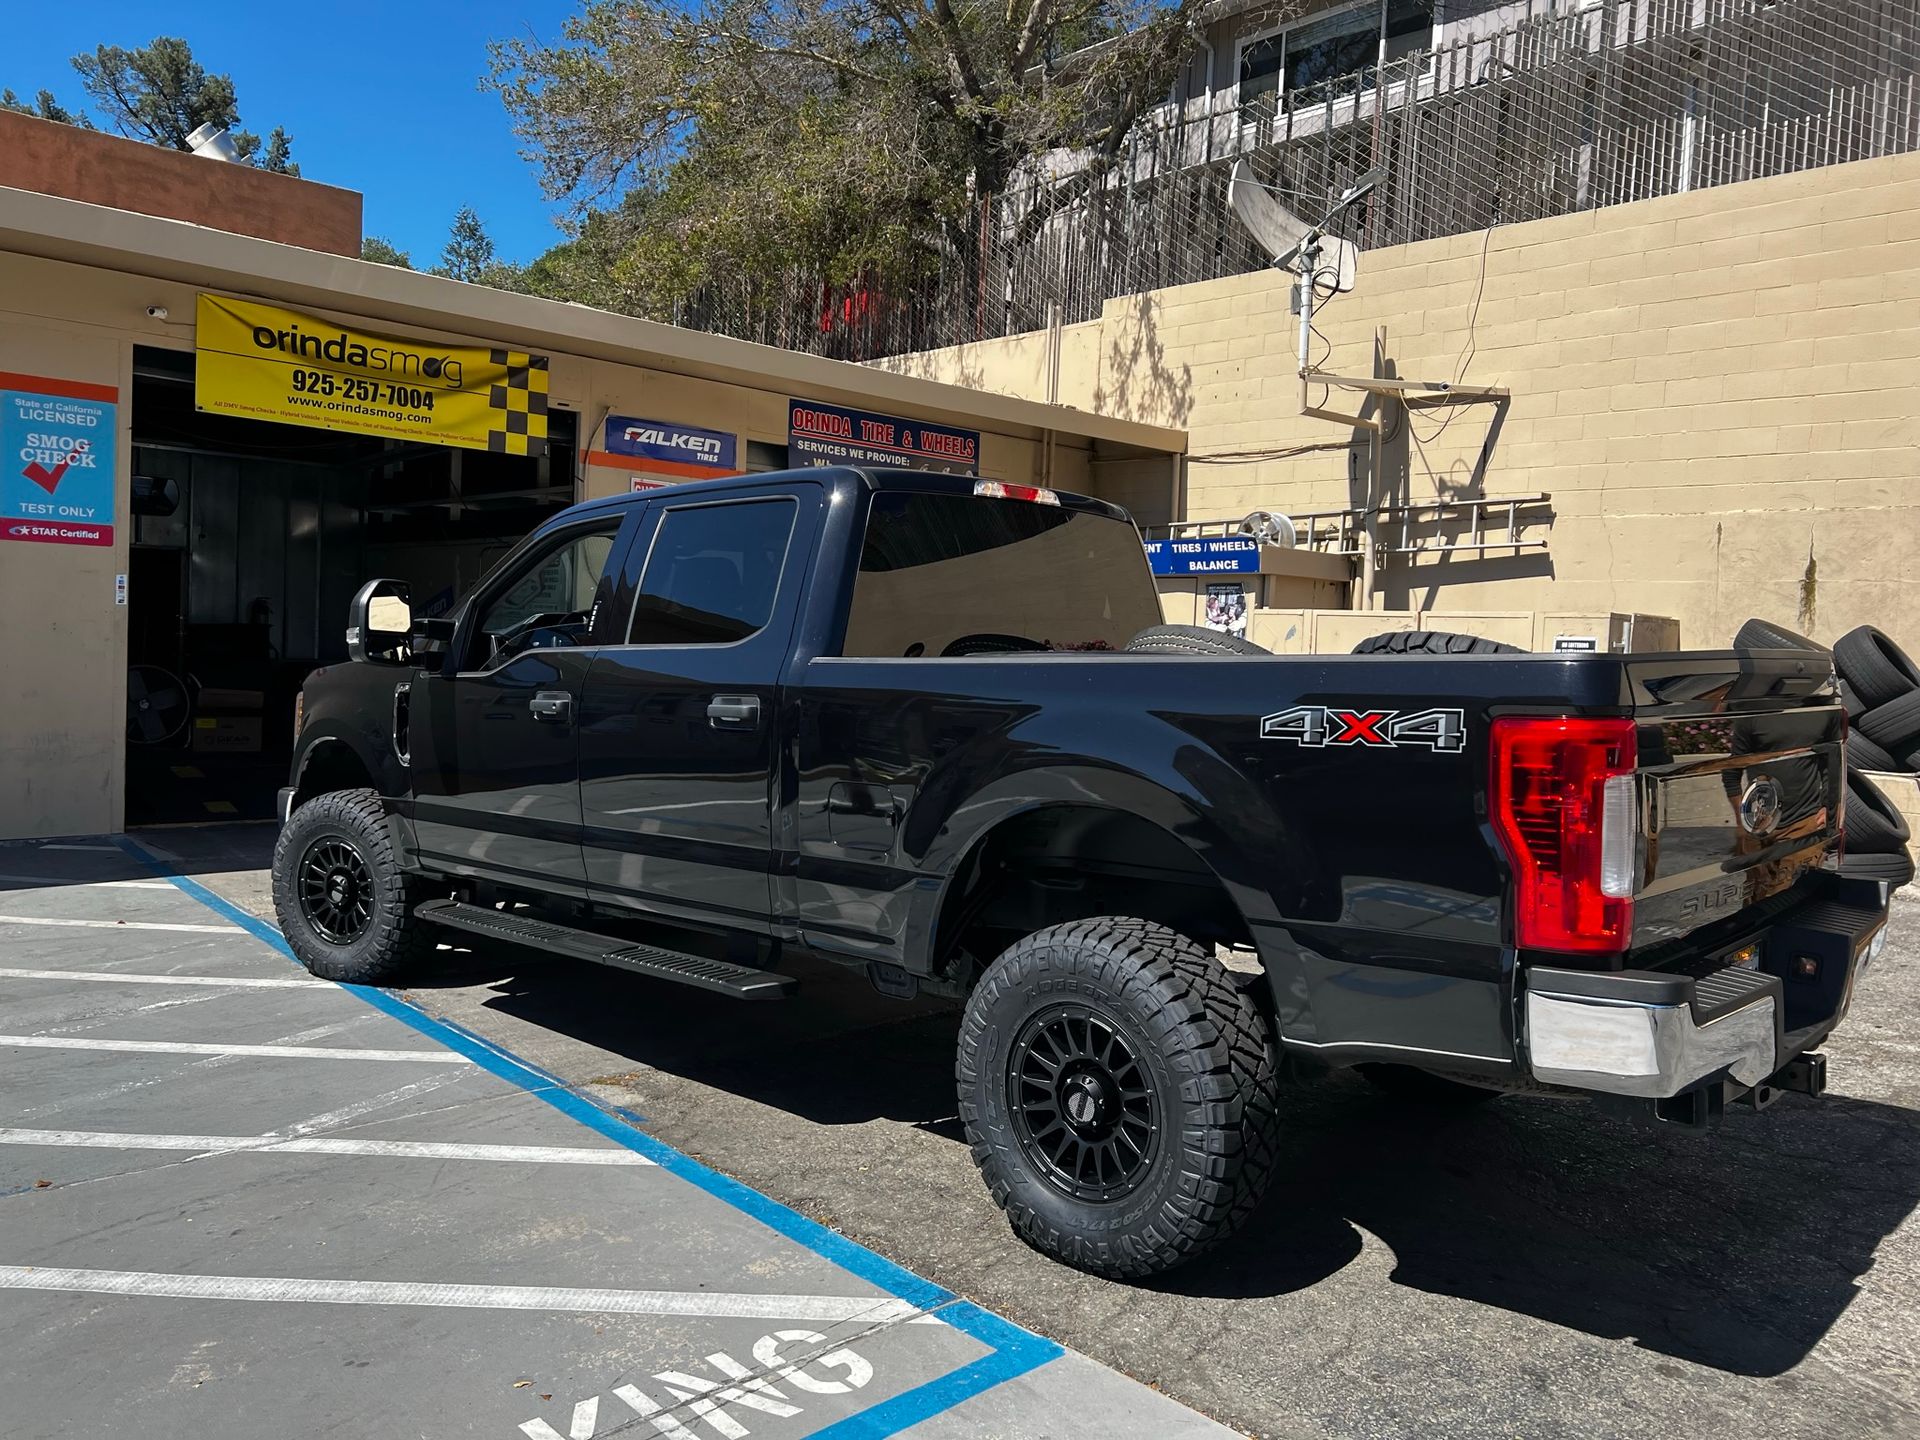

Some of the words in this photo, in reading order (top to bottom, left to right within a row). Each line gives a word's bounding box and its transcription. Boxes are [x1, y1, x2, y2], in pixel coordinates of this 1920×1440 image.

[252, 324, 463, 389] orindasmog
[292, 369, 435, 411] 925-257-7004
[15, 398, 42, 408] State
[43, 401, 53, 410] of
[55, 402, 102, 416] California
[287, 394, 433, 424] www.orindasmog.com
[19, 408, 97, 427] LICENSED
[26, 433, 90, 452] SMOG
[624, 427, 721, 454] FALKEN
[792, 408, 851, 438] ORINDA
[860, 418, 895, 445] TIRE
[902, 431, 914, 448] &
[920, 431, 975, 458] WHEELS
[20, 447, 97, 468] CHECK
[696, 452, 719, 463] TIRES
[797, 440, 847, 457] SERVICES
[849, 448, 864, 459] WE
[866, 451, 910, 467] PROVIDE:
[19, 502, 54, 515] TEST
[58, 505, 96, 518] ONLY
[31, 527, 59, 537] STAR
[60, 529, 100, 539] Certified
[1171, 543, 1201, 553] TIRES
[1209, 541, 1256, 552] WHEELS
[1189, 560, 1239, 571] BALANCE
[1260, 706, 1467, 753] 4X4
